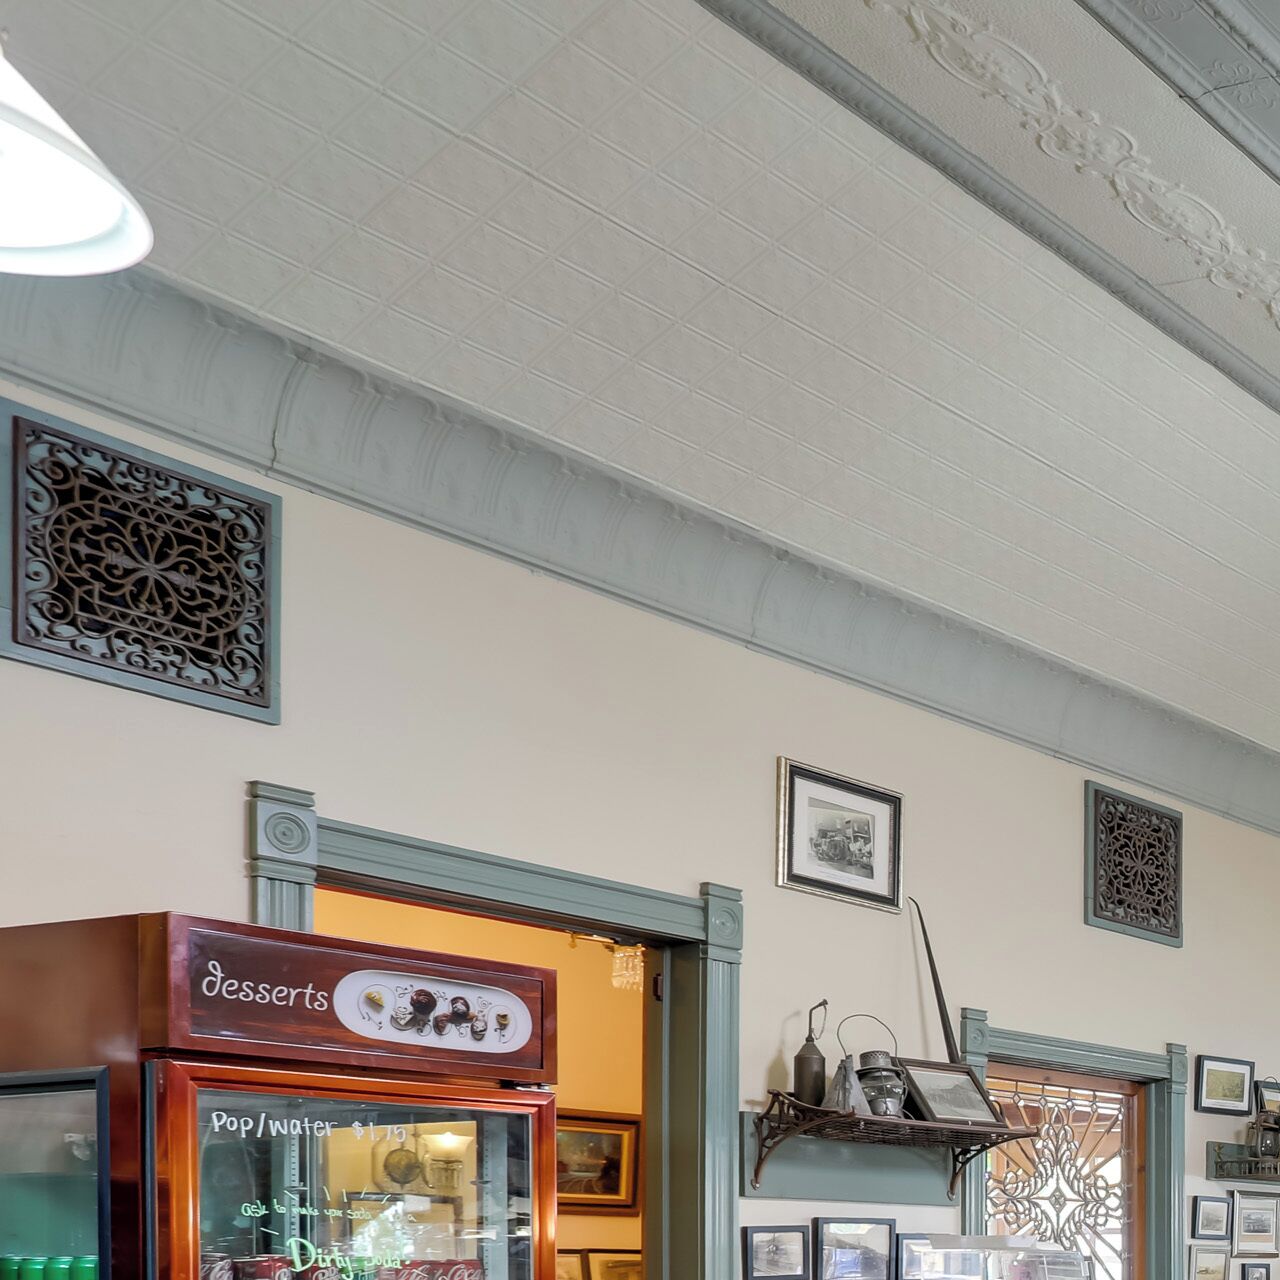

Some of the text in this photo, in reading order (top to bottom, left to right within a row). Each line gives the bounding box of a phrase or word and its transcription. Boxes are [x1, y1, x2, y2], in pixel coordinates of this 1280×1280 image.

[201, 960, 329, 1012] desserts
[211, 1111, 407, 1142] Pop/water $1.75
[240, 1200, 269, 1217] ask
[274, 1199, 287, 1215] to
[293, 1202, 319, 1217] make
[287, 1237, 354, 1280] Dirty
